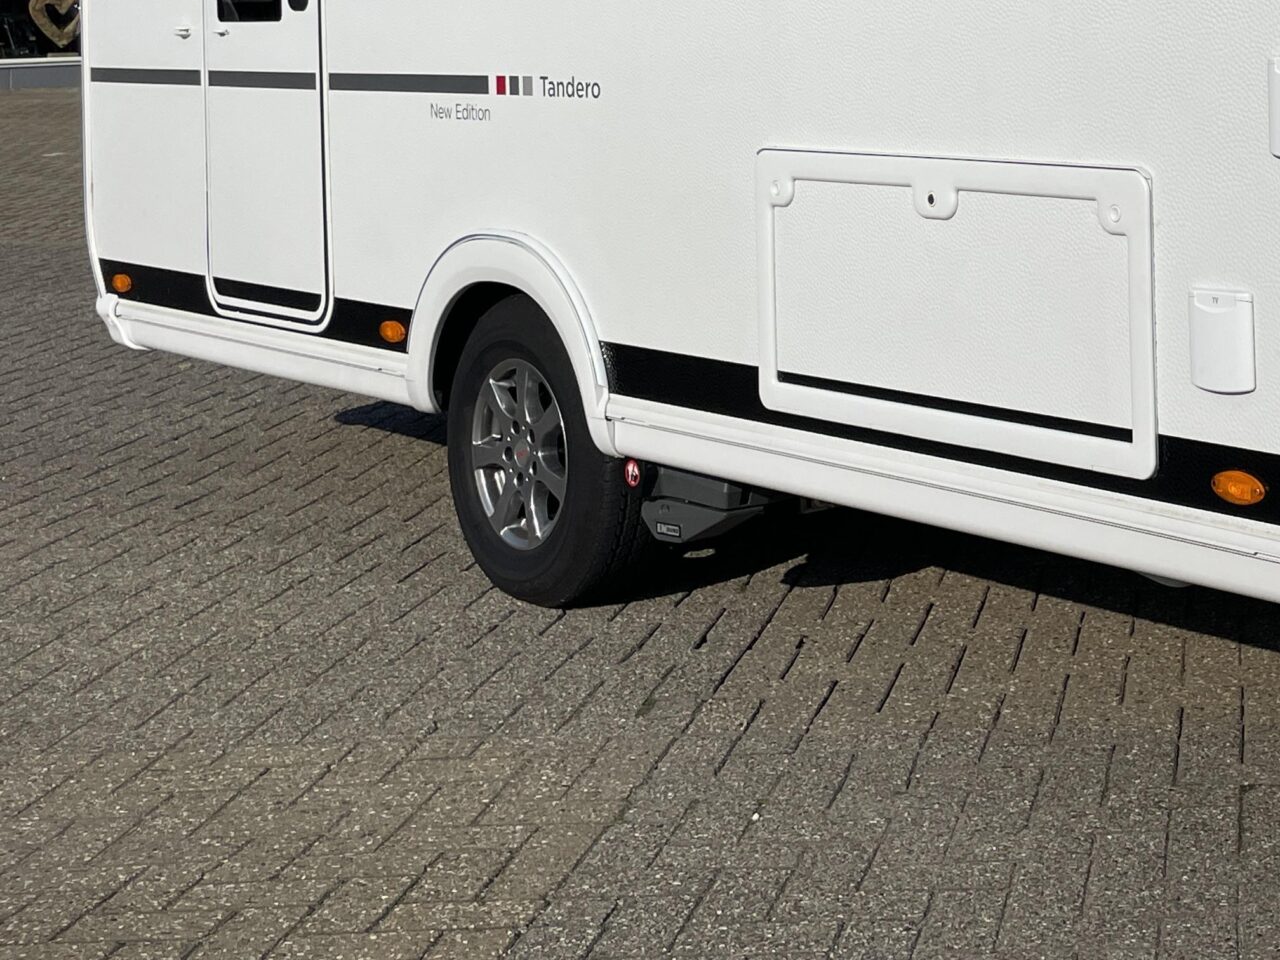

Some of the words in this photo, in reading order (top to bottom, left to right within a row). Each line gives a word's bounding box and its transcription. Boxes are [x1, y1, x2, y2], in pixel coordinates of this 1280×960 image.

[539, 76, 601, 99] Tandero
[430, 103, 453, 120] New
[455, 103, 491, 121] Edition
